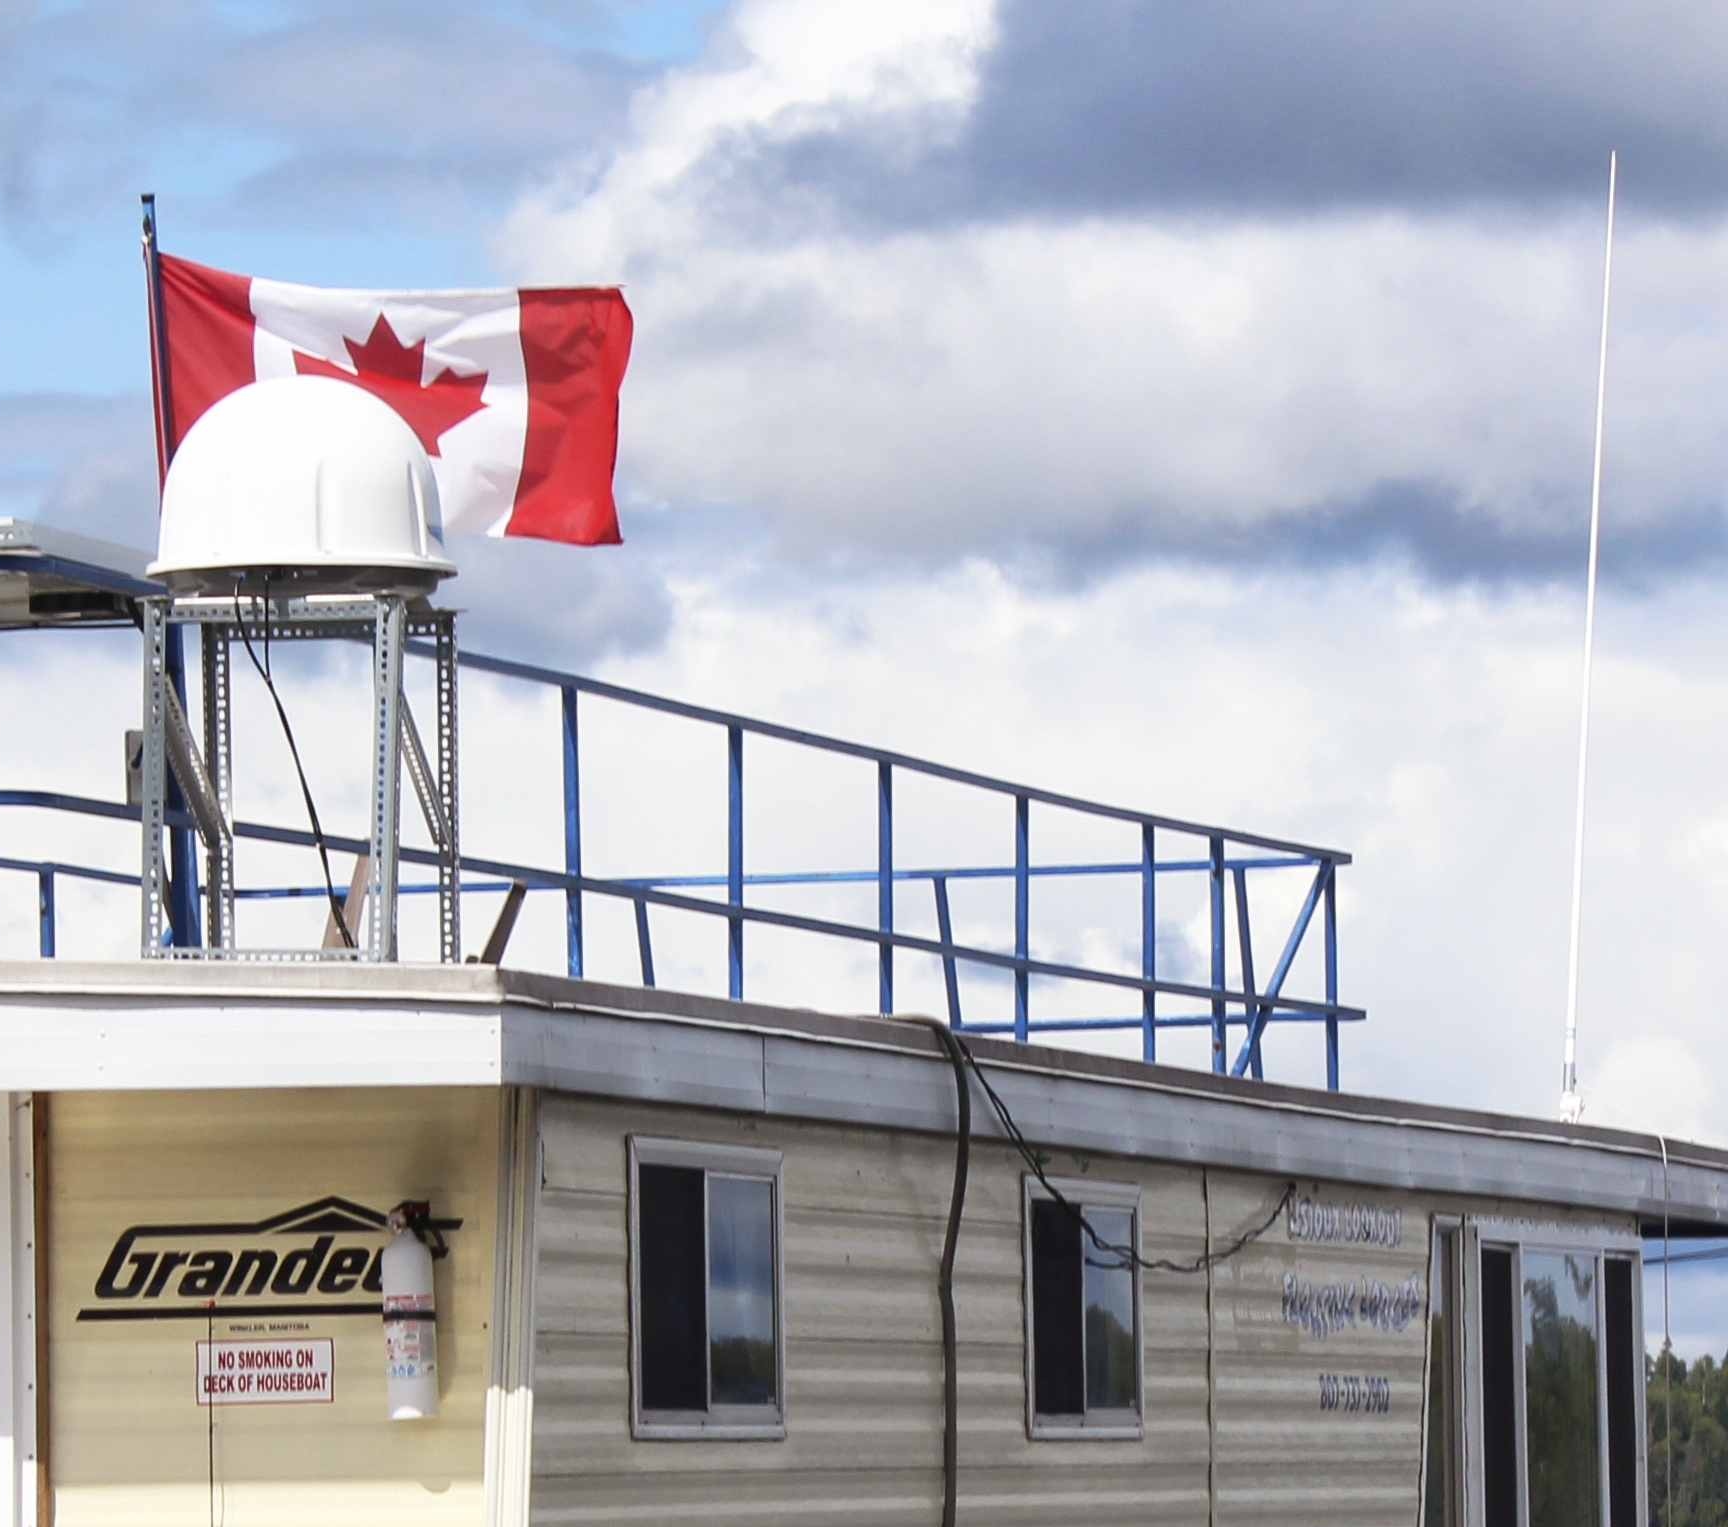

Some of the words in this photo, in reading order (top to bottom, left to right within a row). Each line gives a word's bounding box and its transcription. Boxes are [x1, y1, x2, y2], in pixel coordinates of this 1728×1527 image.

[218, 1351, 234, 1370] NO
[238, 1350, 293, 1369] SMOKING
[297, 1349, 313, 1368] ON
[204, 1375, 235, 1394] DECK
[238, 1374, 254, 1393] OF
[257, 1372, 328, 1392] HOUSEBOAT
